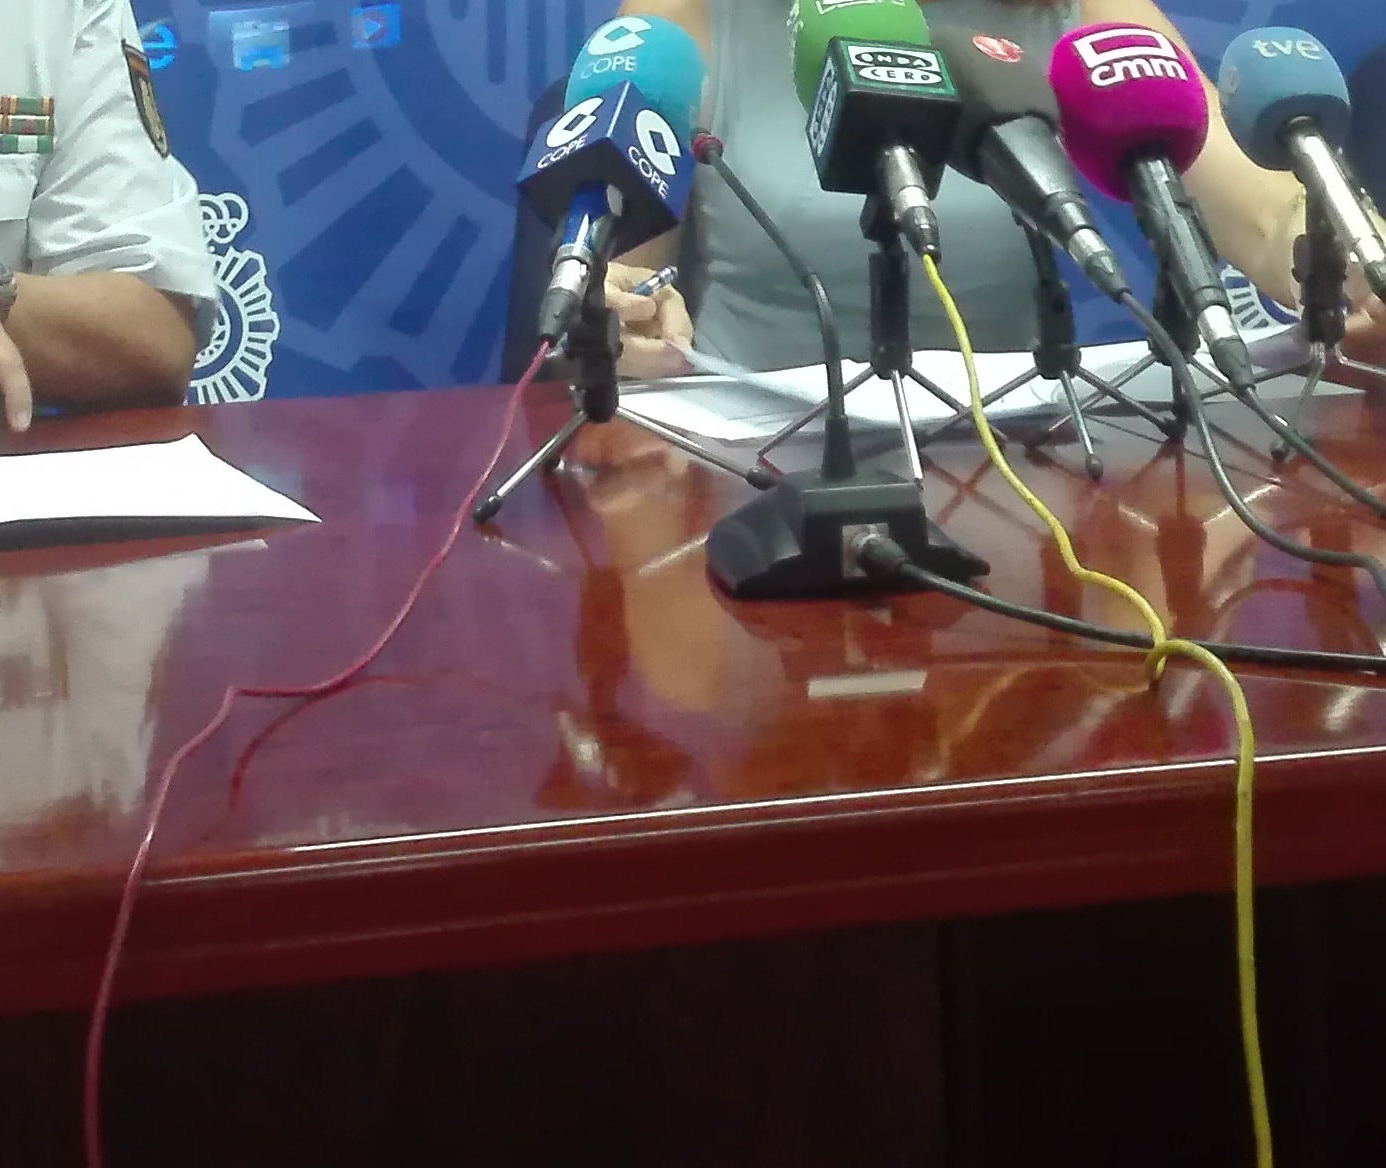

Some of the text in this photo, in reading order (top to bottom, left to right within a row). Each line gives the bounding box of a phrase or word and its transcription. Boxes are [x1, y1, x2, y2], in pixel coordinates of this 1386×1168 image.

[858, 52, 929, 68] ONDA
[1253, 39, 1323, 60] tve
[580, 55, 637, 80] COPE
[870, 68, 931, 82] CERO
[1090, 57, 1189, 88] cmm
[537, 133, 589, 169] COPE
[627, 145, 670, 200] COPE
